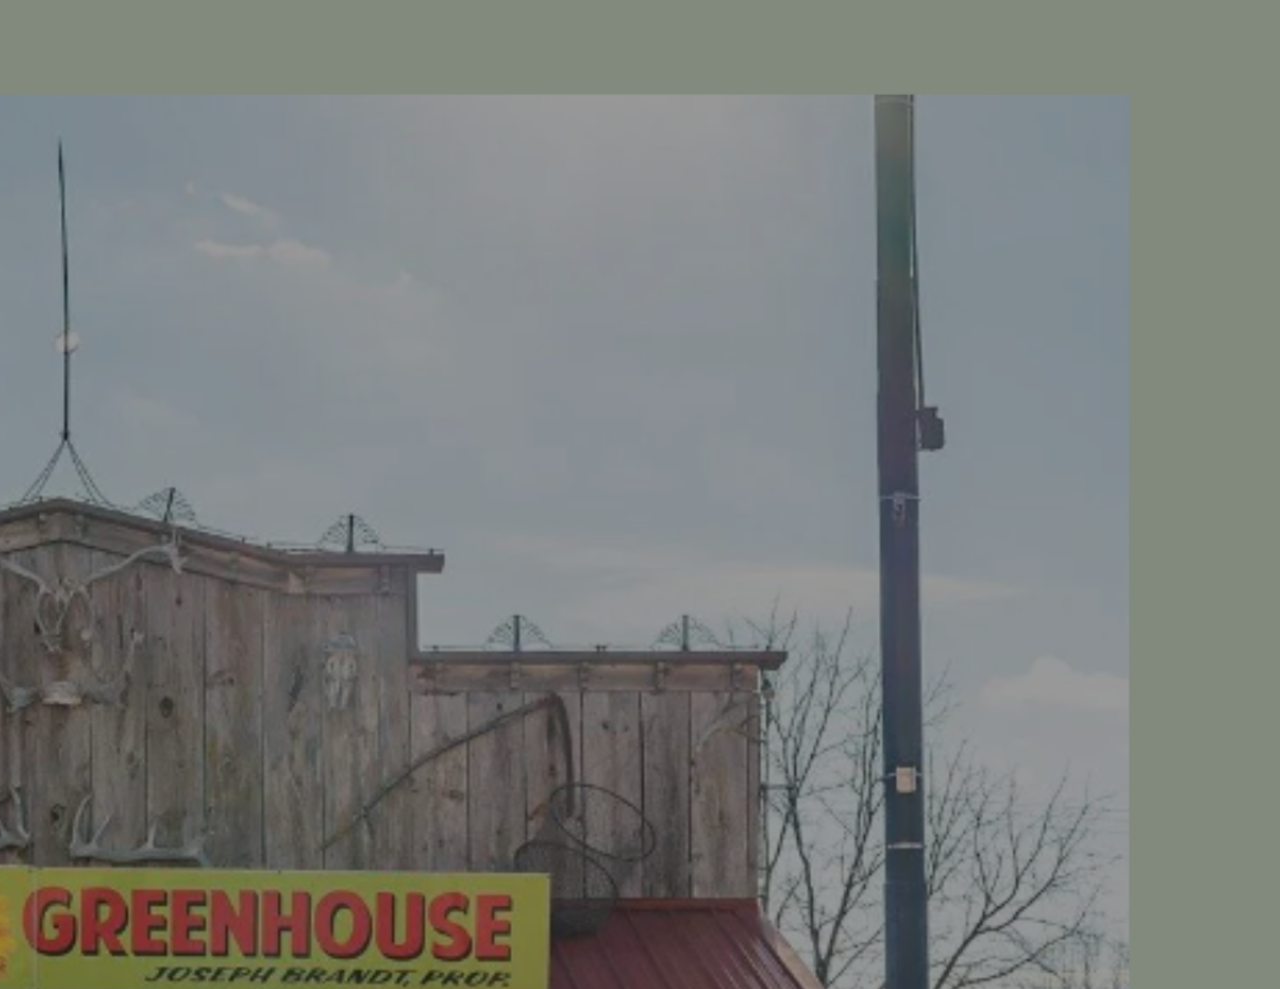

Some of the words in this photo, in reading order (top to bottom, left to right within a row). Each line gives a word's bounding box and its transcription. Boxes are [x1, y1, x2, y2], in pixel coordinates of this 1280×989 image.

[22, 886, 512, 962] GREENHOUSE
[145, 967, 275, 985] JOSEPH
[280, 967, 416, 987] BRANDT,
